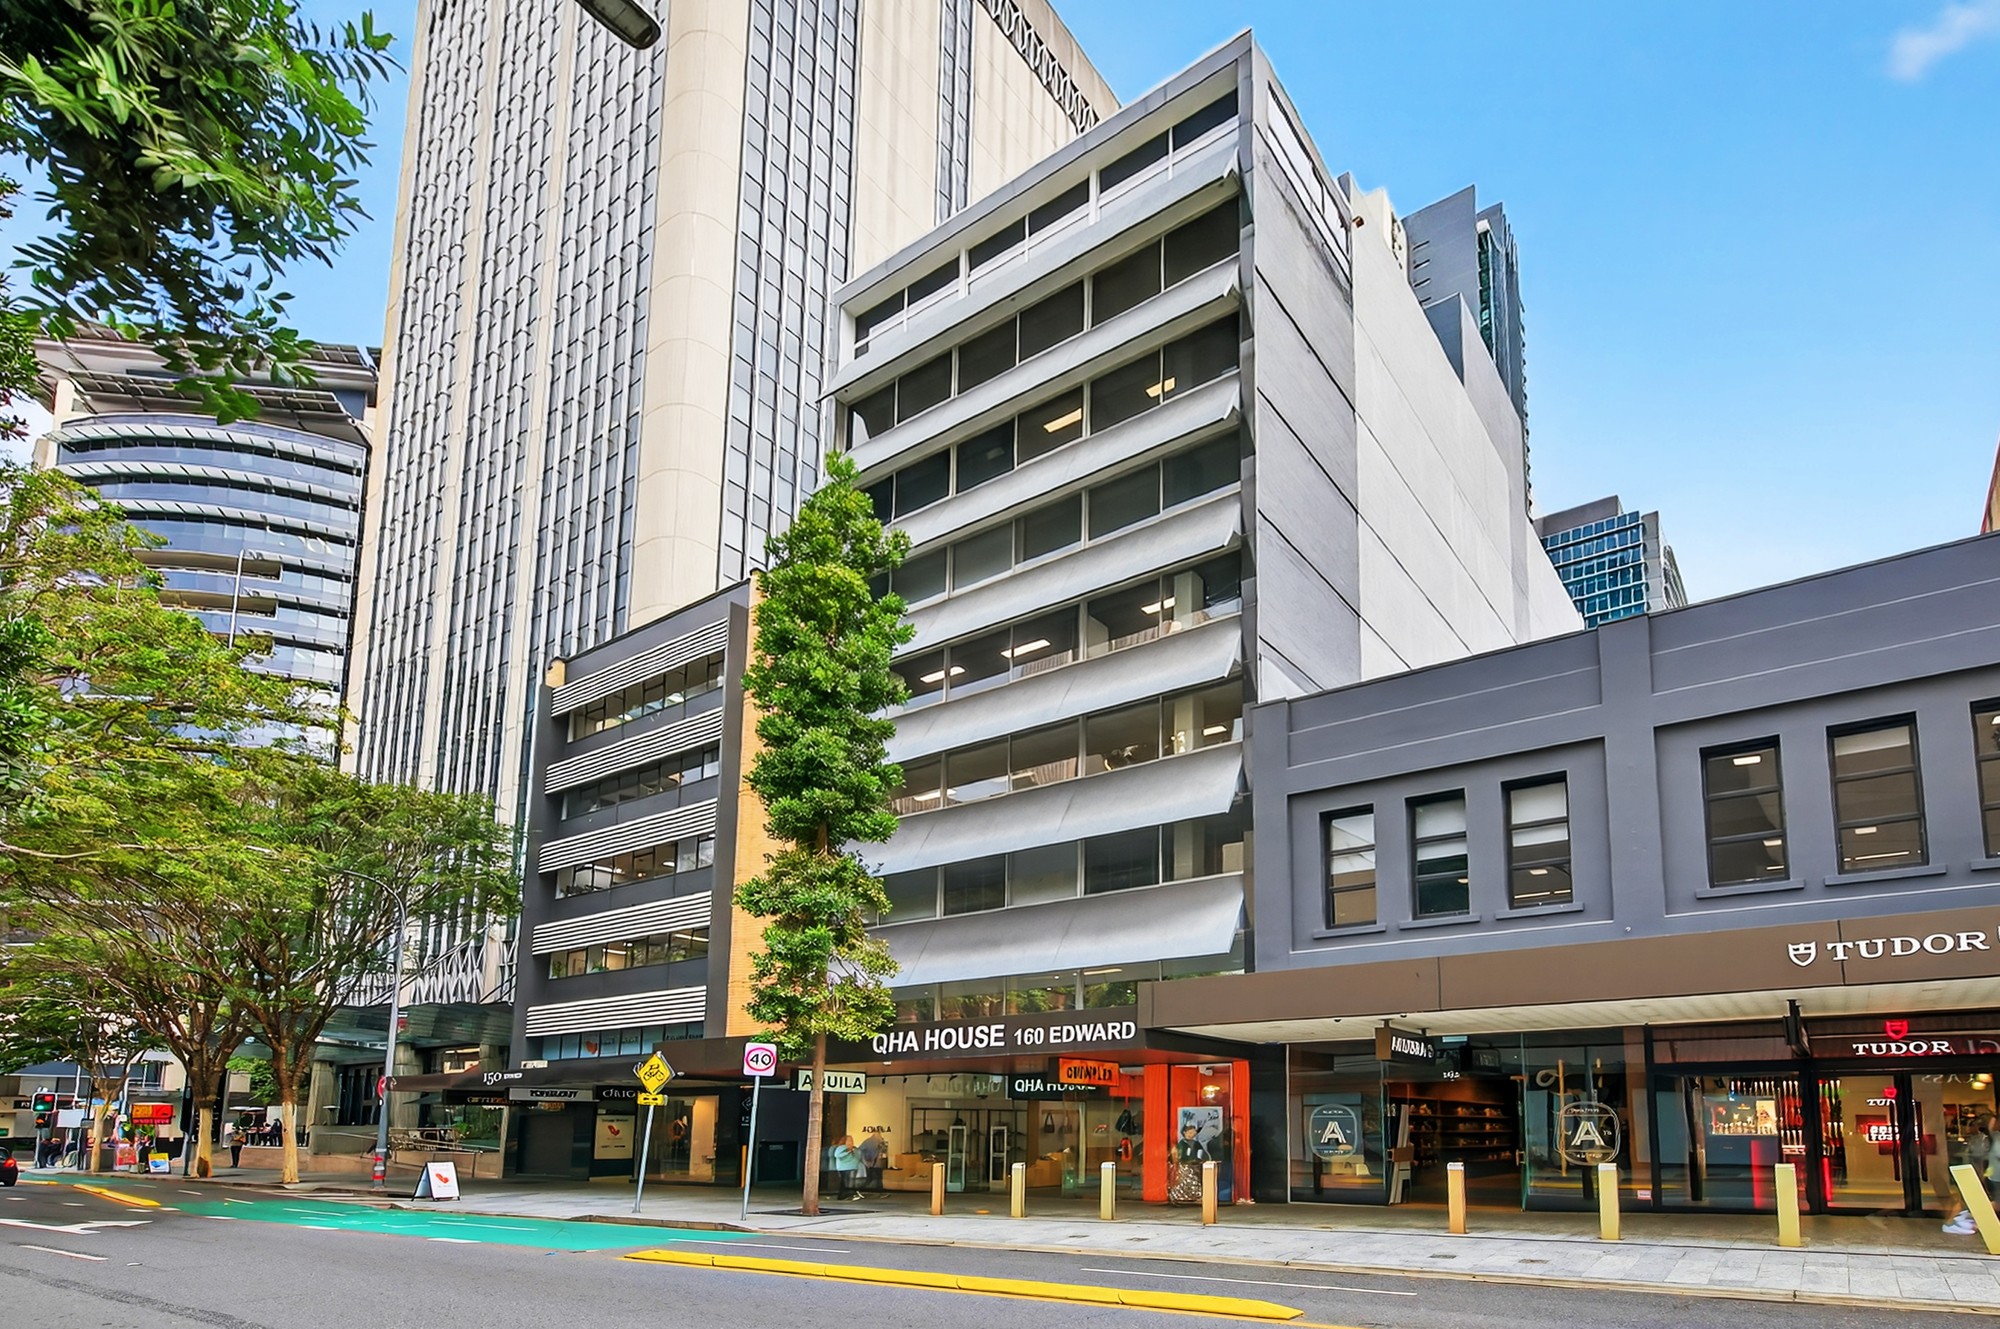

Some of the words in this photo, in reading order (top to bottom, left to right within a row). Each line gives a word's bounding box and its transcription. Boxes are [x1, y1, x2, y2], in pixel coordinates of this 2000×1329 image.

[1827, 931, 1991, 961] TUDOR
[872, 1030, 919, 1055] QHA
[924, 1024, 1006, 1051] HOUSE
[1013, 1028, 1044, 1045] 160
[1049, 1021, 1137, 1043] EDWARD
[1852, 1040, 1951, 1055] TUDOR
[750, 1053, 772, 1066] 40
[801, 1074, 864, 1090] AUILA
[1014, 1079, 1045, 1093] QHA
